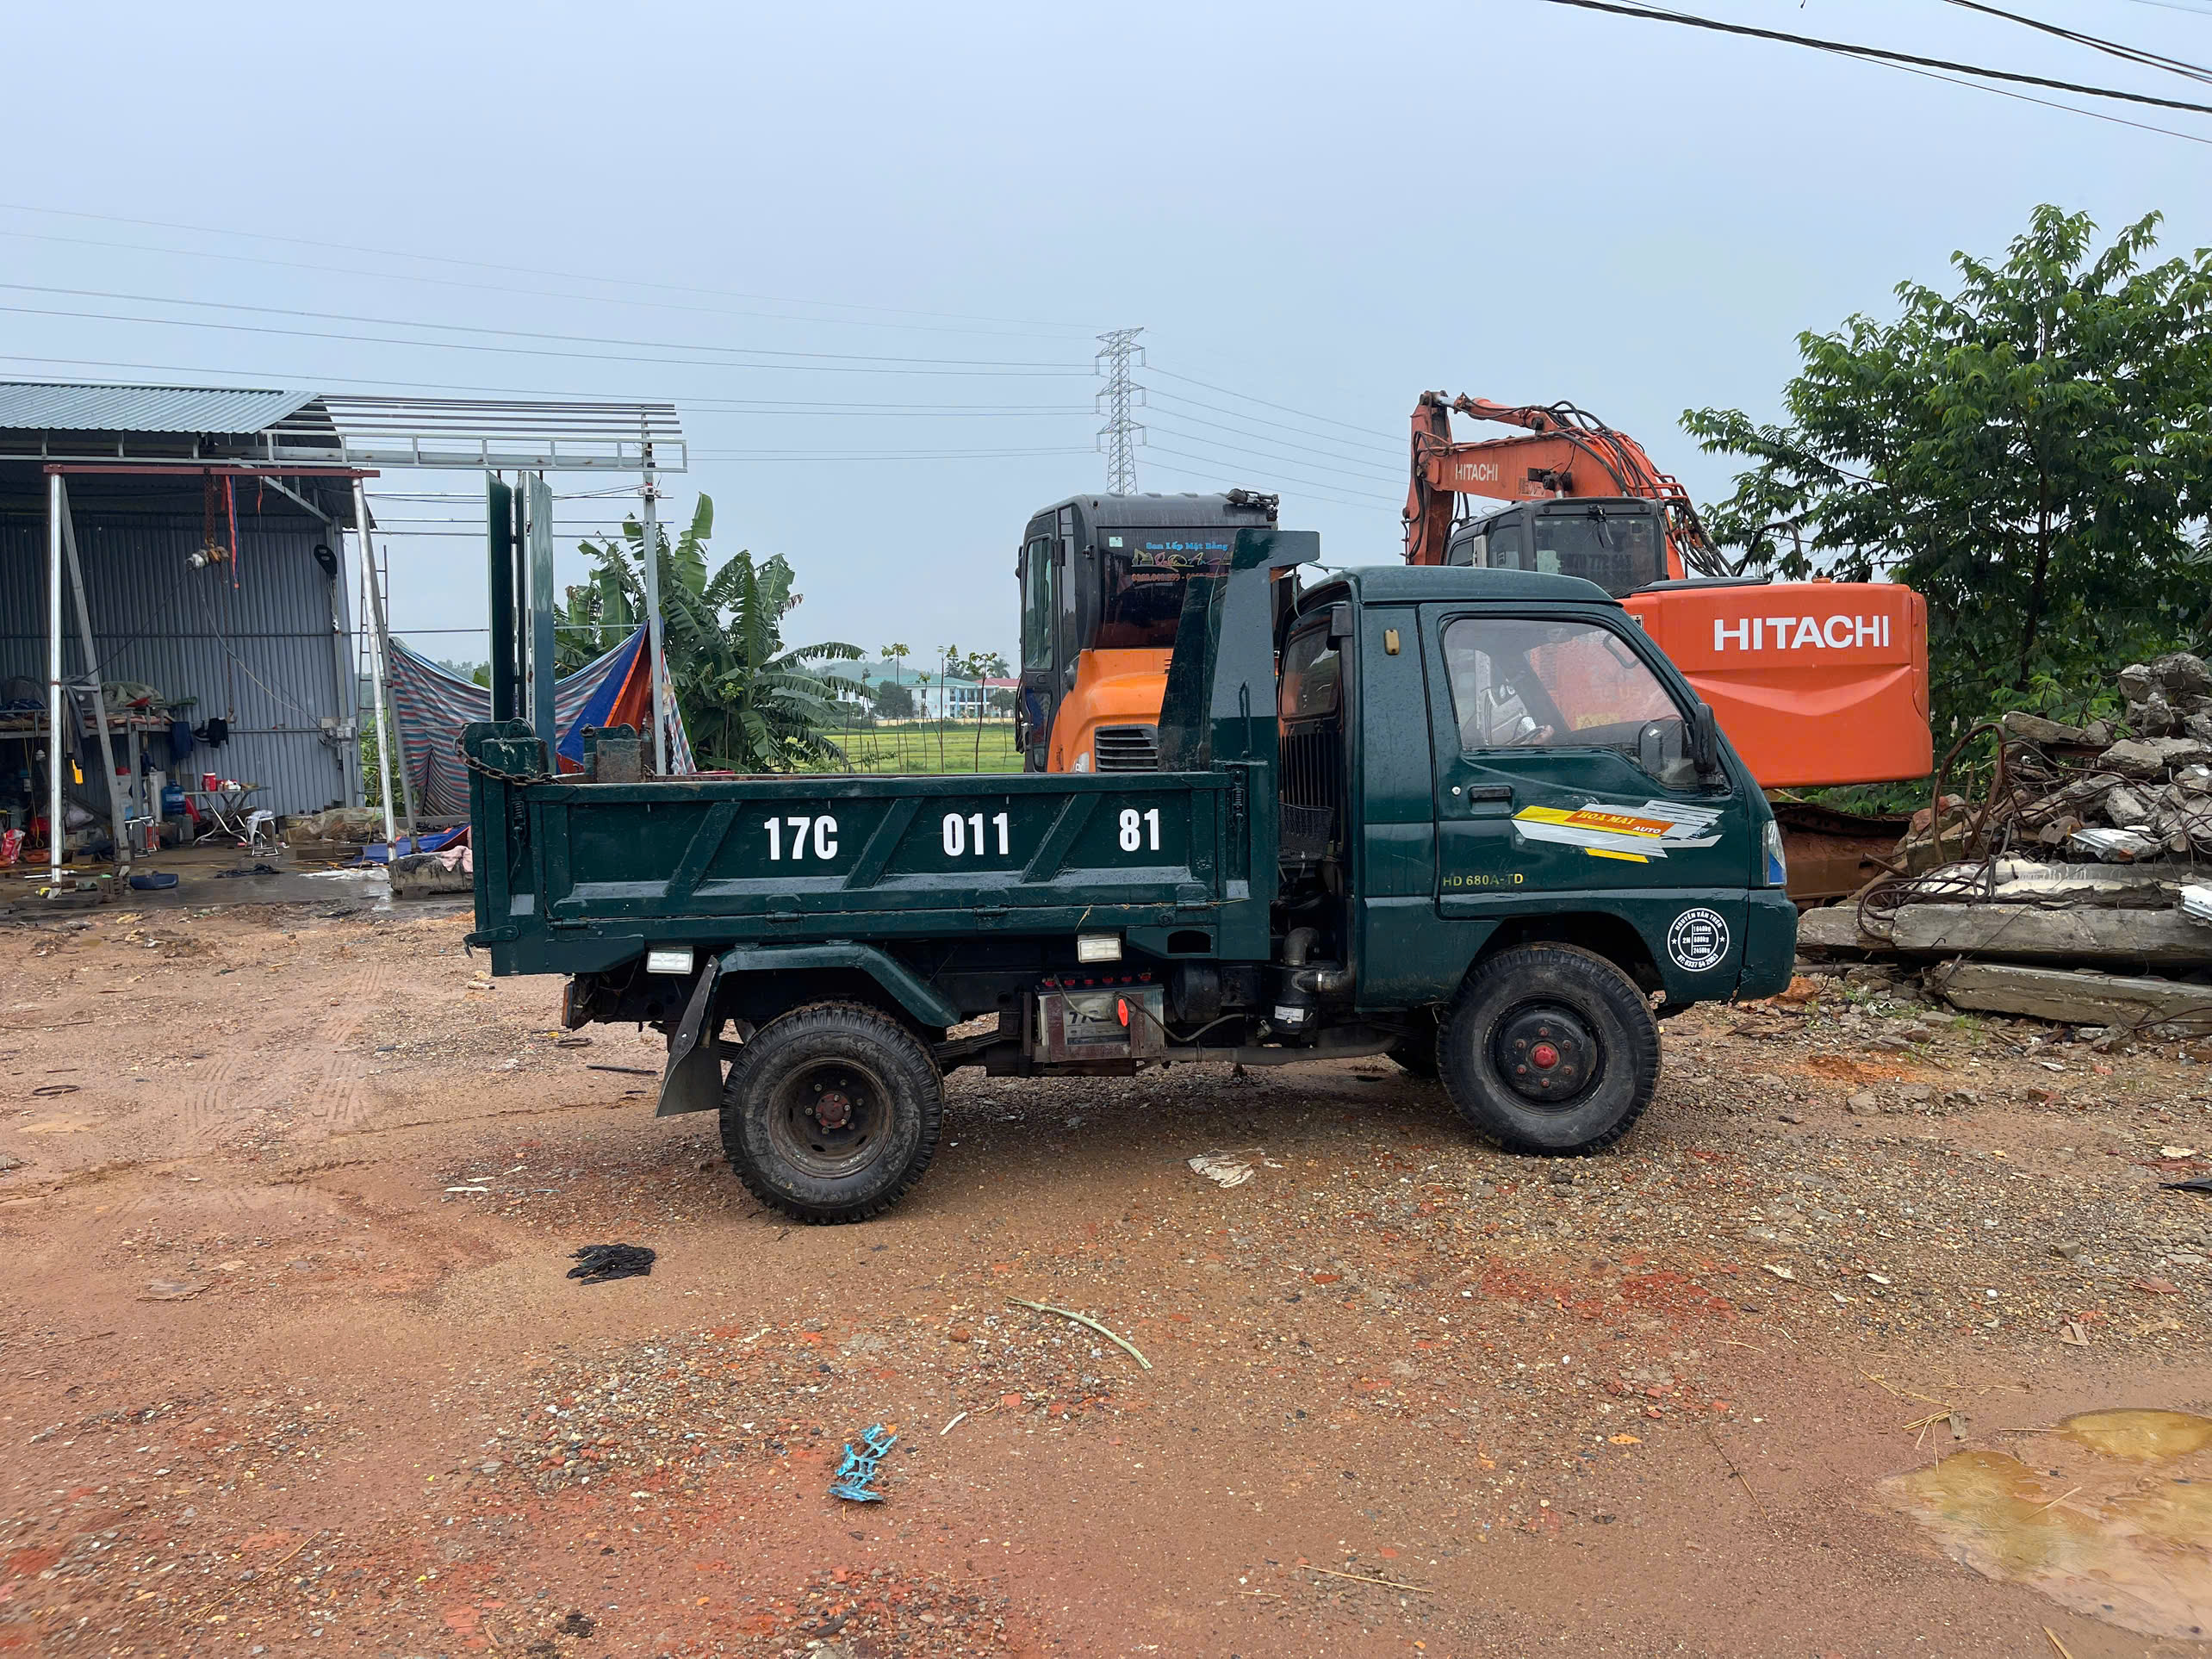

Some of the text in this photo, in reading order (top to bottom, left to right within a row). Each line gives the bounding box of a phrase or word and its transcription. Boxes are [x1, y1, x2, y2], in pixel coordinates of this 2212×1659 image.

[1455, 463, 1498, 482] HITACHI
[1714, 615, 1889, 651] HITACHI
[1576, 811, 1637, 826] HOA MAI
[763, 808, 1159, 861] 17C 011 81
[1632, 825, 1662, 835] AUTO
[1442, 875, 1463, 887] HD
